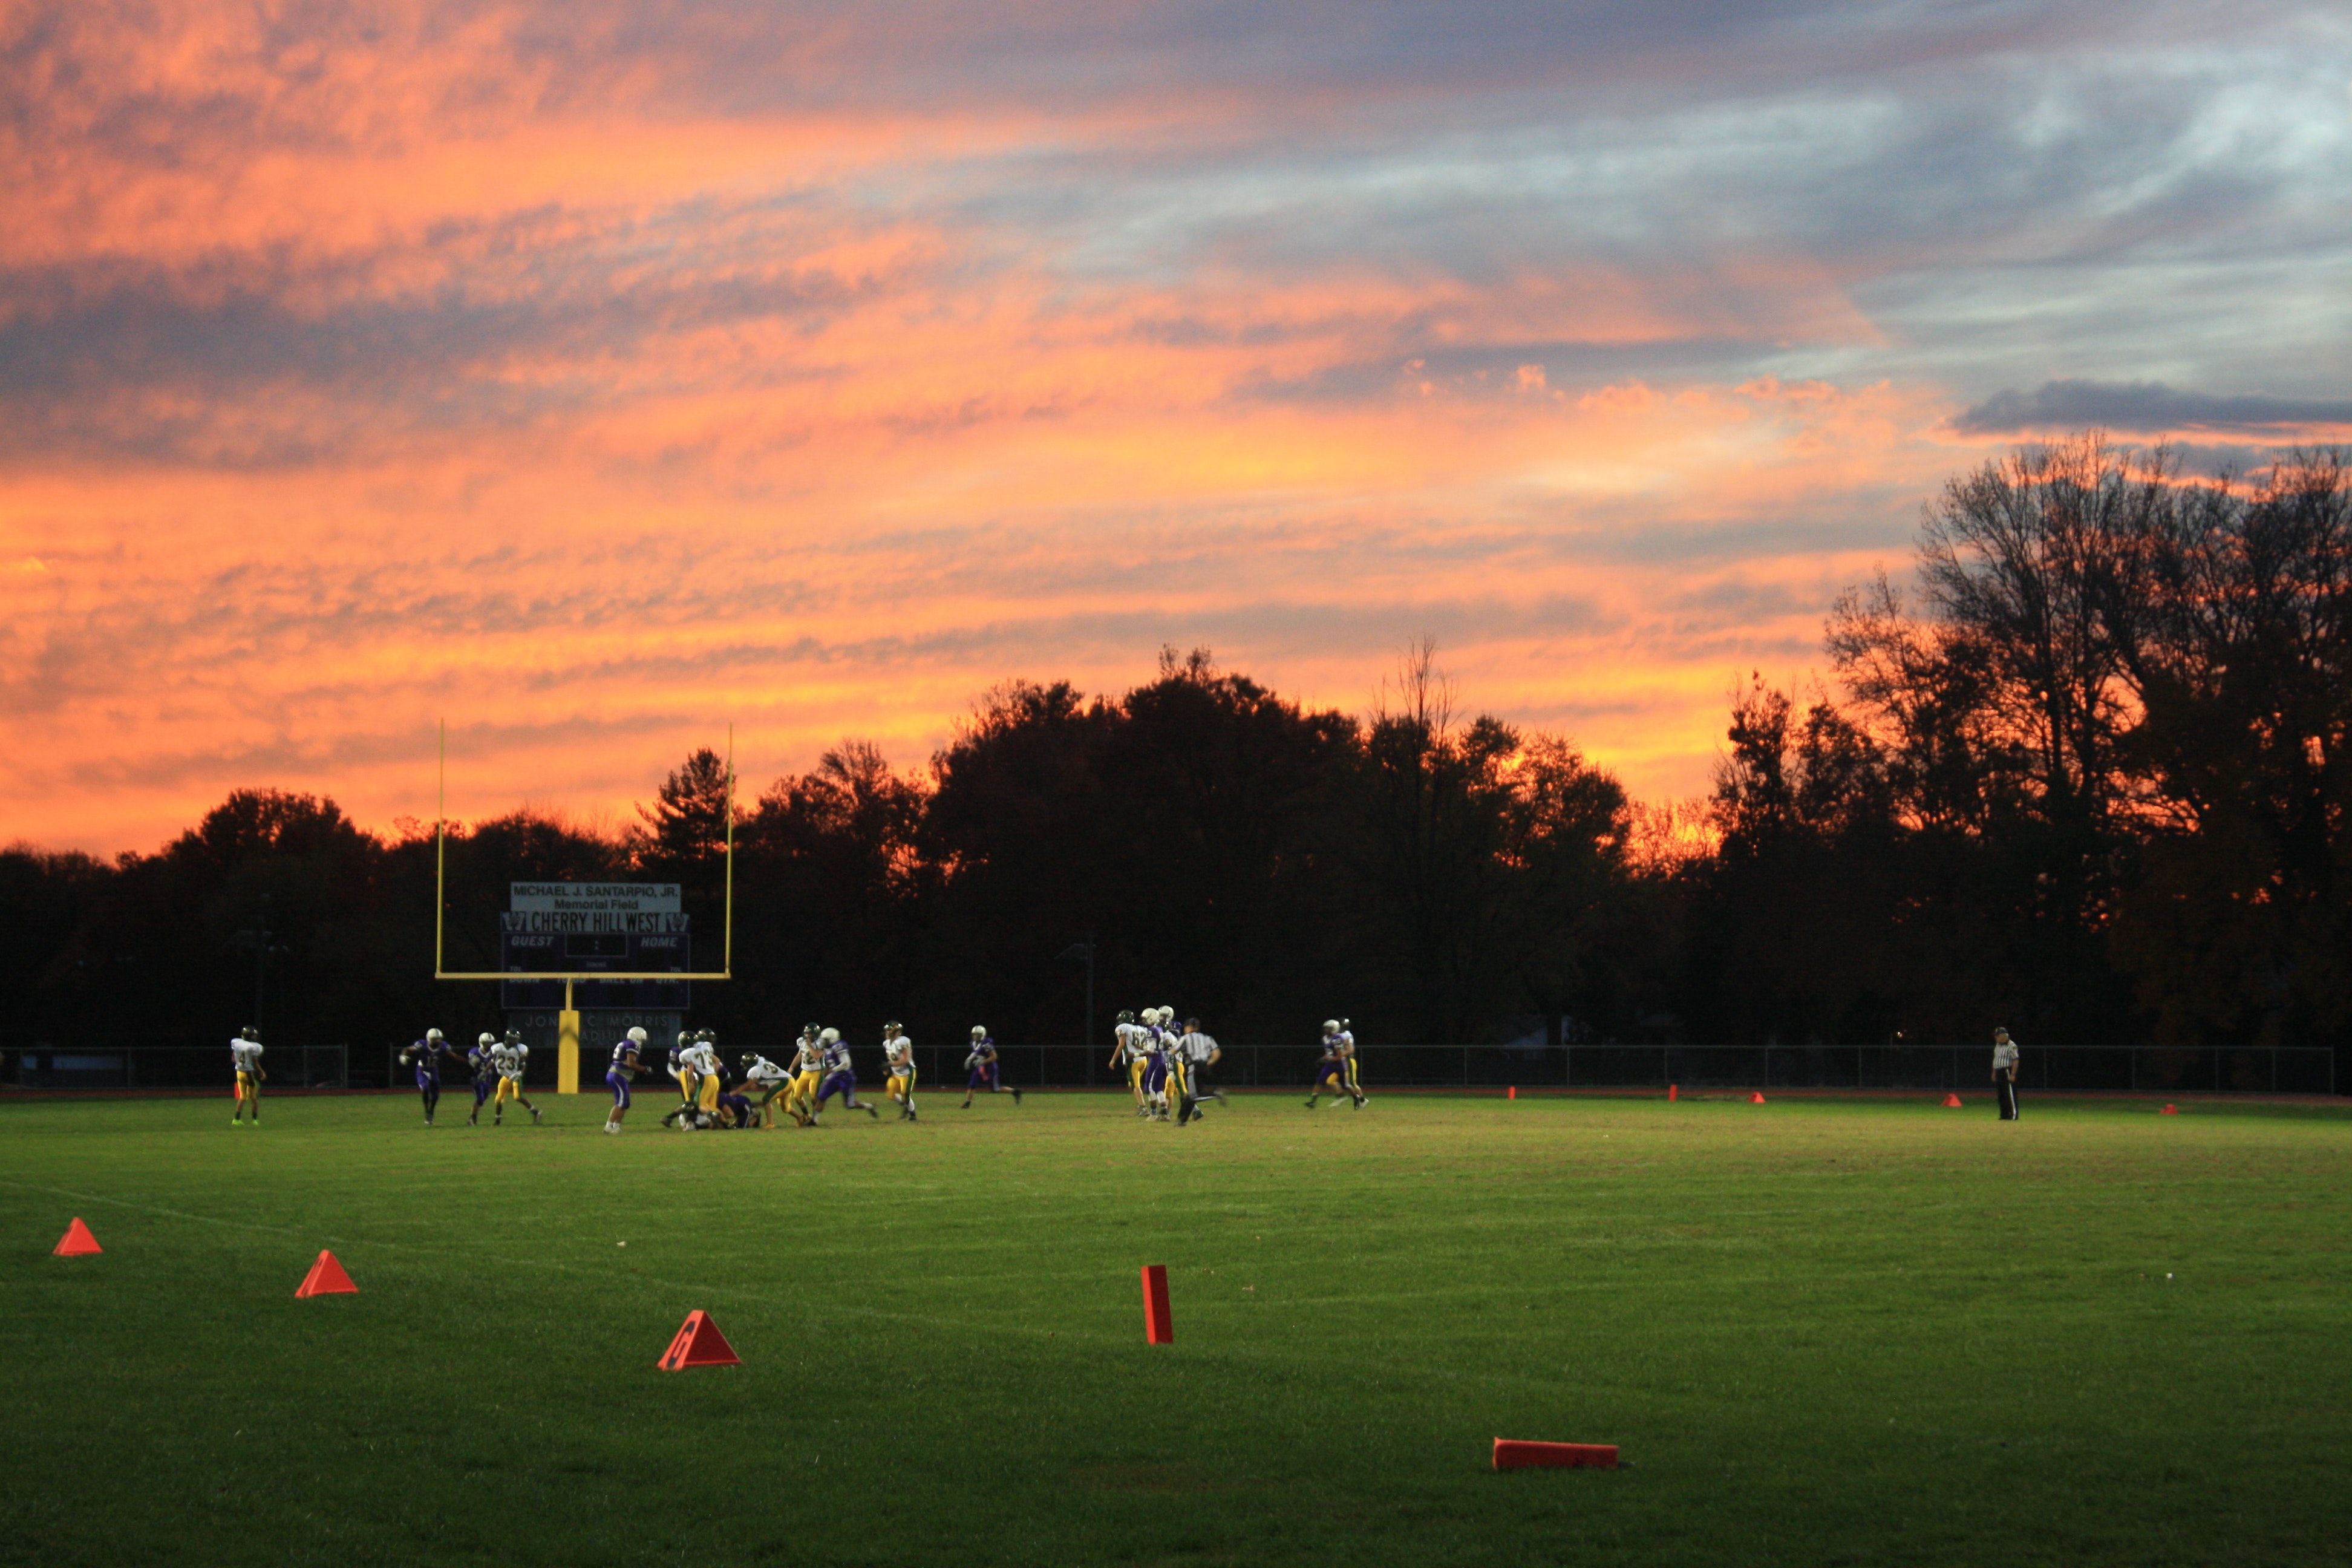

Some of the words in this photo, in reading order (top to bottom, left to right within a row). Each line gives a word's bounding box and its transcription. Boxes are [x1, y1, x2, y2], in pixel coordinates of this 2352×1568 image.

[514, 886, 569, 895] MICHAEL
[573, 887, 581, 896] J.
[586, 886, 656, 898] SANTARPIO,
[661, 887, 678, 897] JR.
[555, 899, 607, 909] Memorial
[612, 900, 638, 910] Field
[532, 912, 587, 932] CHERRY
[593, 912, 623, 932] HILL
[626, 913, 660, 932] WEST
[511, 936, 554, 947] GUEST
[641, 937, 678, 947] HOME
[587, 1016, 596, 1027] C
[609, 1016, 668, 1027] MORRIS
[498, 1055, 515, 1070] 23
